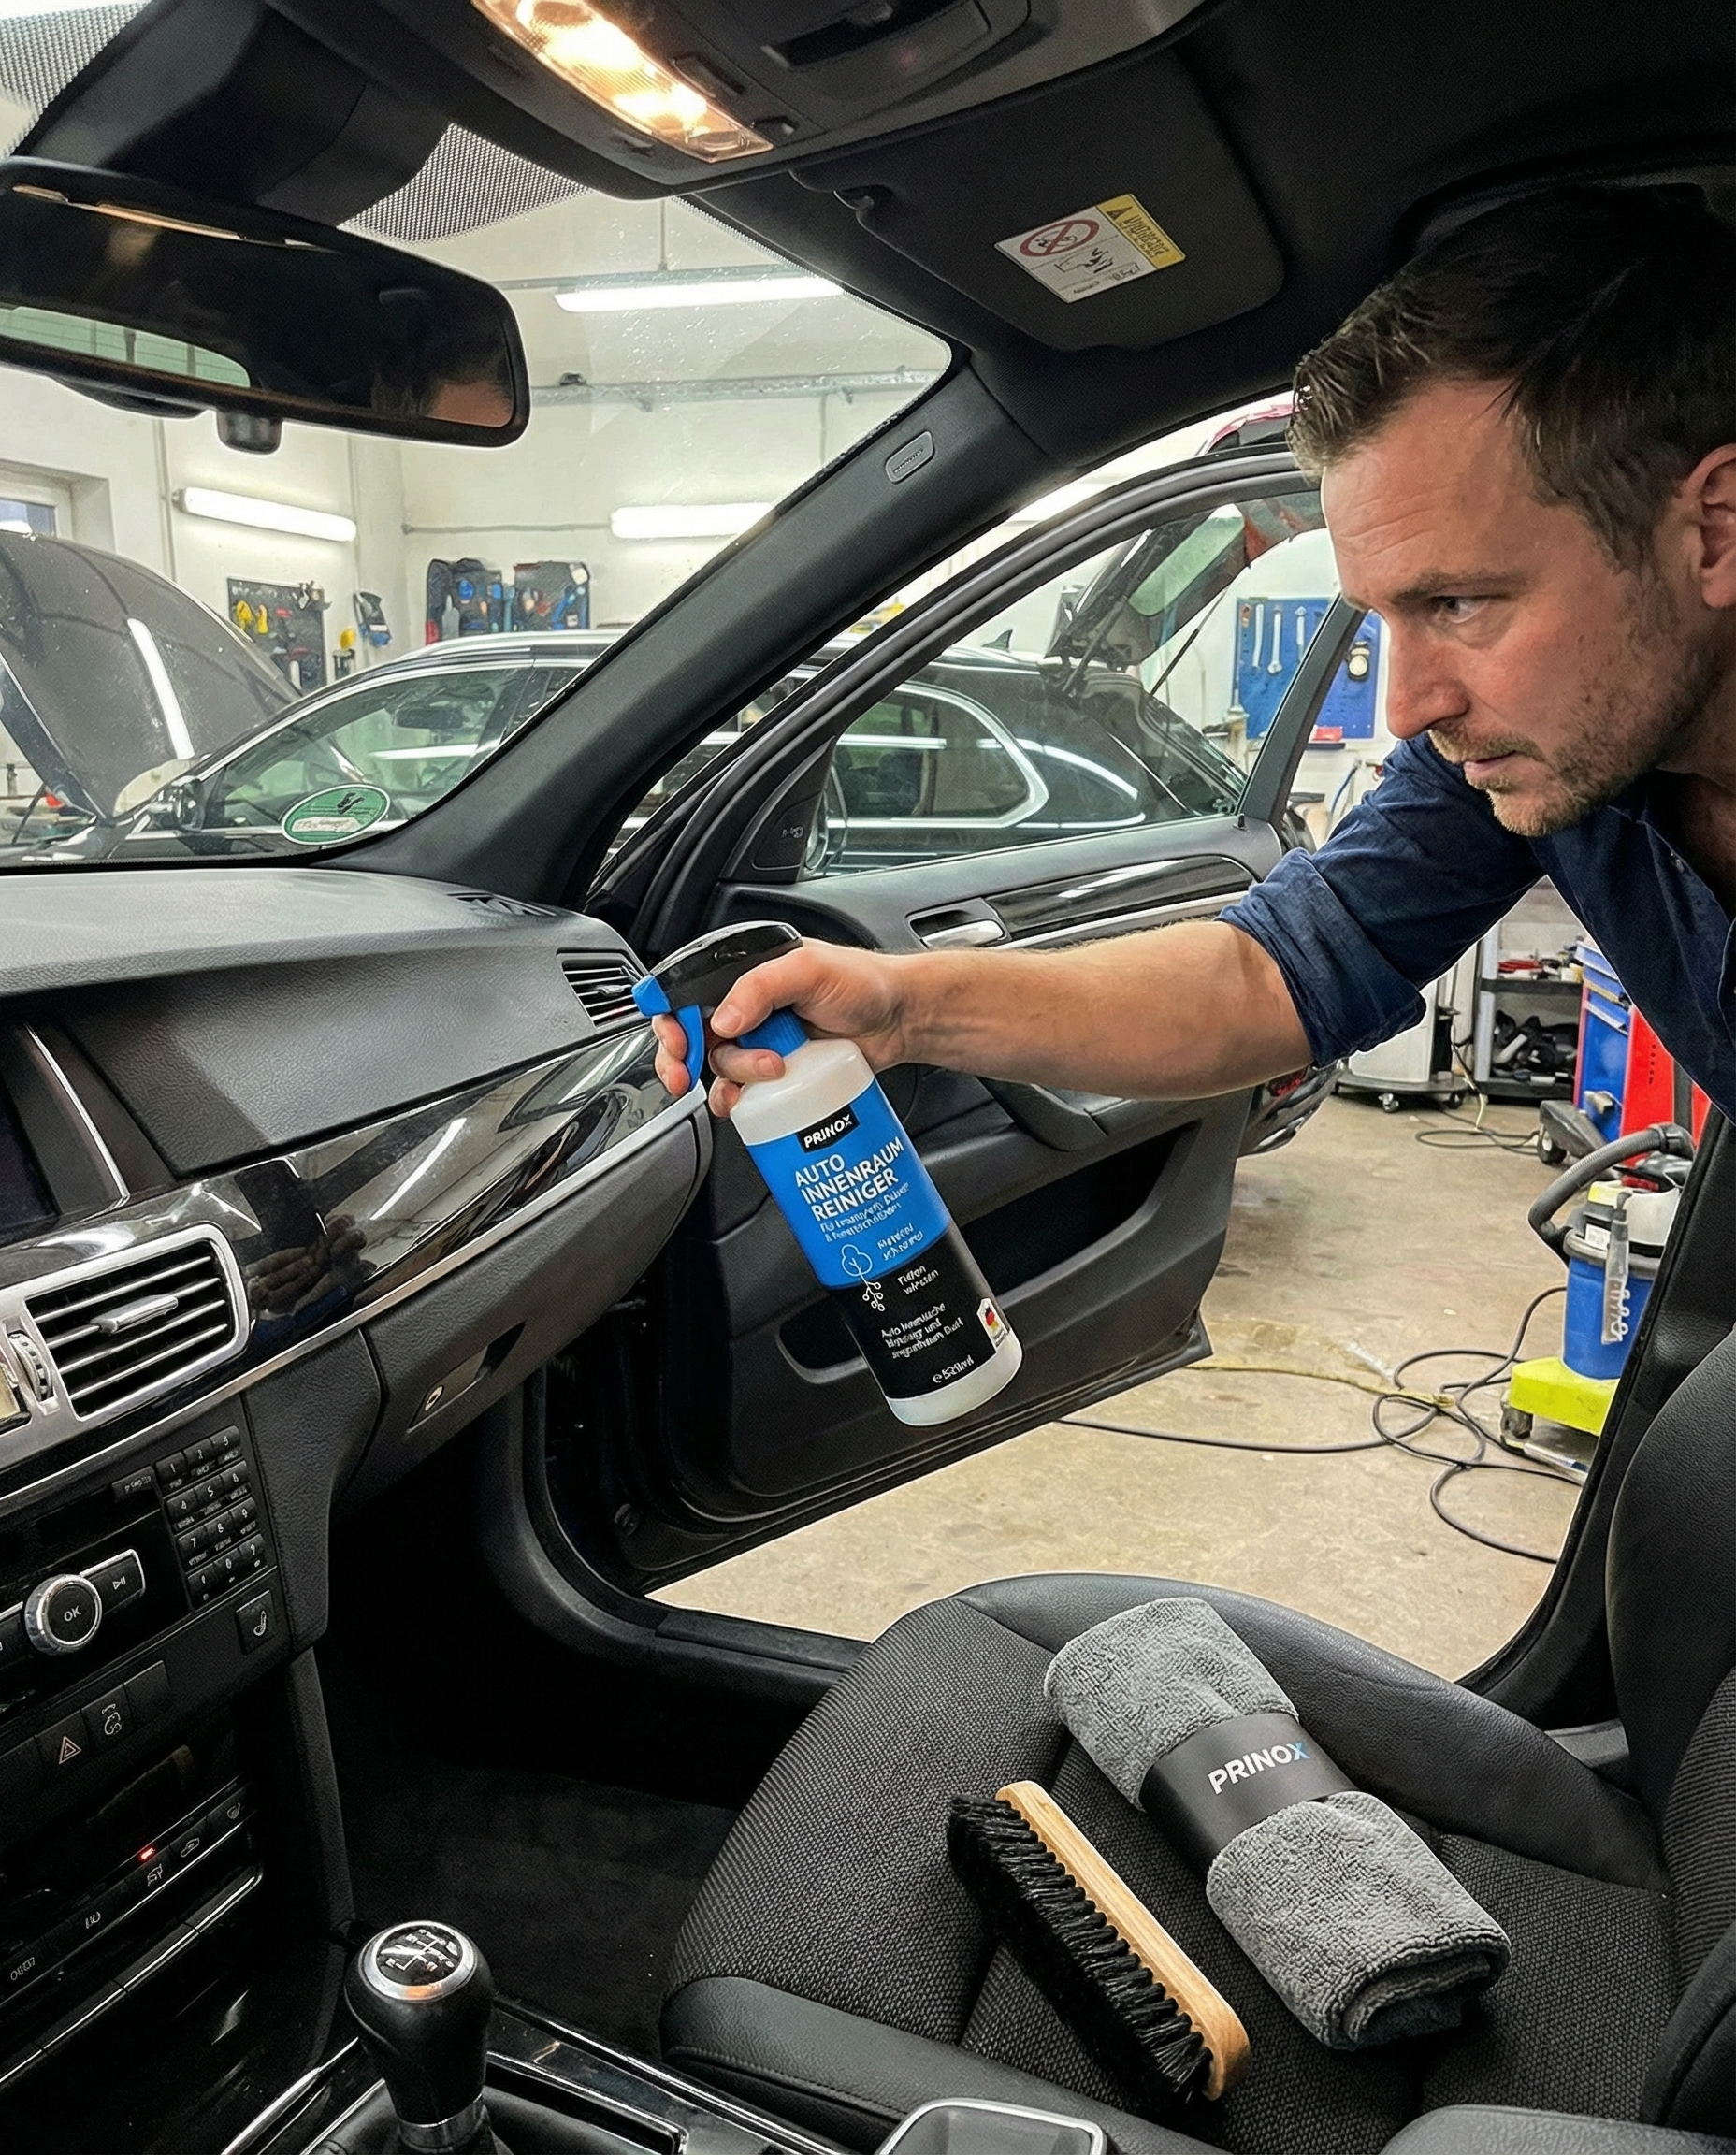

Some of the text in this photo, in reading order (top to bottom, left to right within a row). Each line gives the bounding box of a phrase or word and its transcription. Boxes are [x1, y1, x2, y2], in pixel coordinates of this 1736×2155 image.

[803, 1114, 852, 1149] PRINOX
[795, 1154, 846, 1187] AUTO
[801, 1136, 904, 1205] INNENRAUM
[811, 1167, 899, 1222] REINIGER
[64, 1606, 82, 1622] OK
[1208, 1742, 1310, 1795] PRINOX
